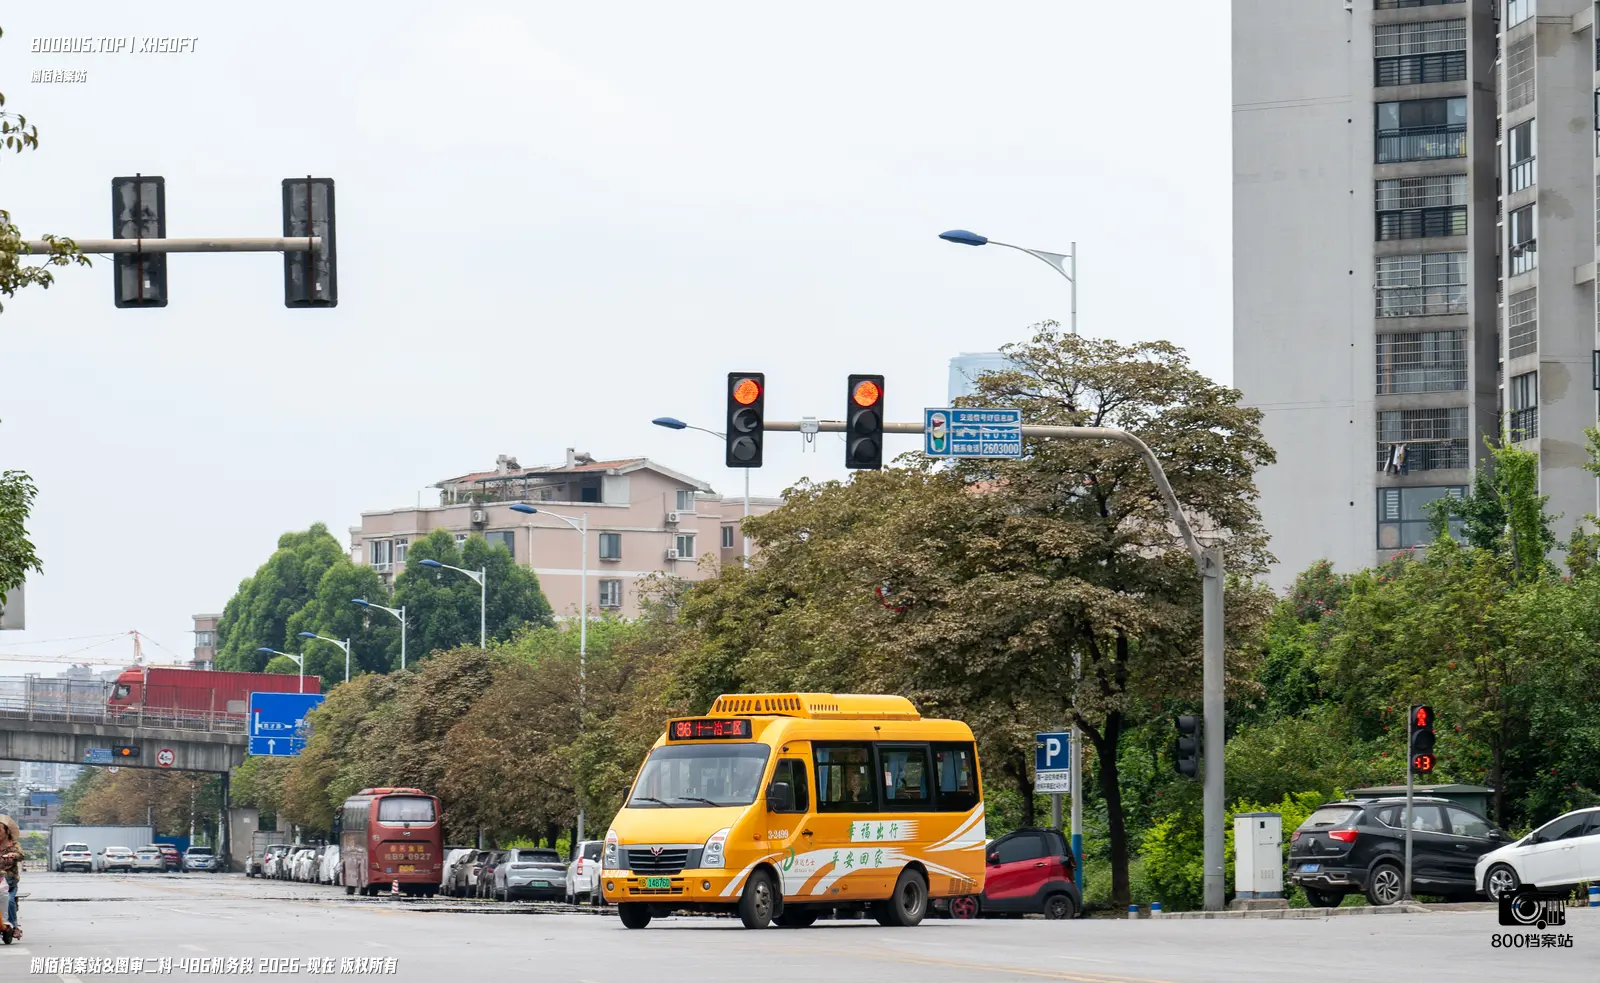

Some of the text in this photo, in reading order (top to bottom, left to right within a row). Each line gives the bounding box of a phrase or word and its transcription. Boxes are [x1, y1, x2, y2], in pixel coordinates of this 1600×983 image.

[982, 443, 1019, 454] 2603000
[676, 721, 692, 737] 86
[1046, 738, 1061, 767] P
[1414, 755, 1431, 771] 43
[767, 829, 790, 840] 3-2499
[845, 822, 899, 841] 幸福出行
[829, 848, 884, 869] 平安回家
